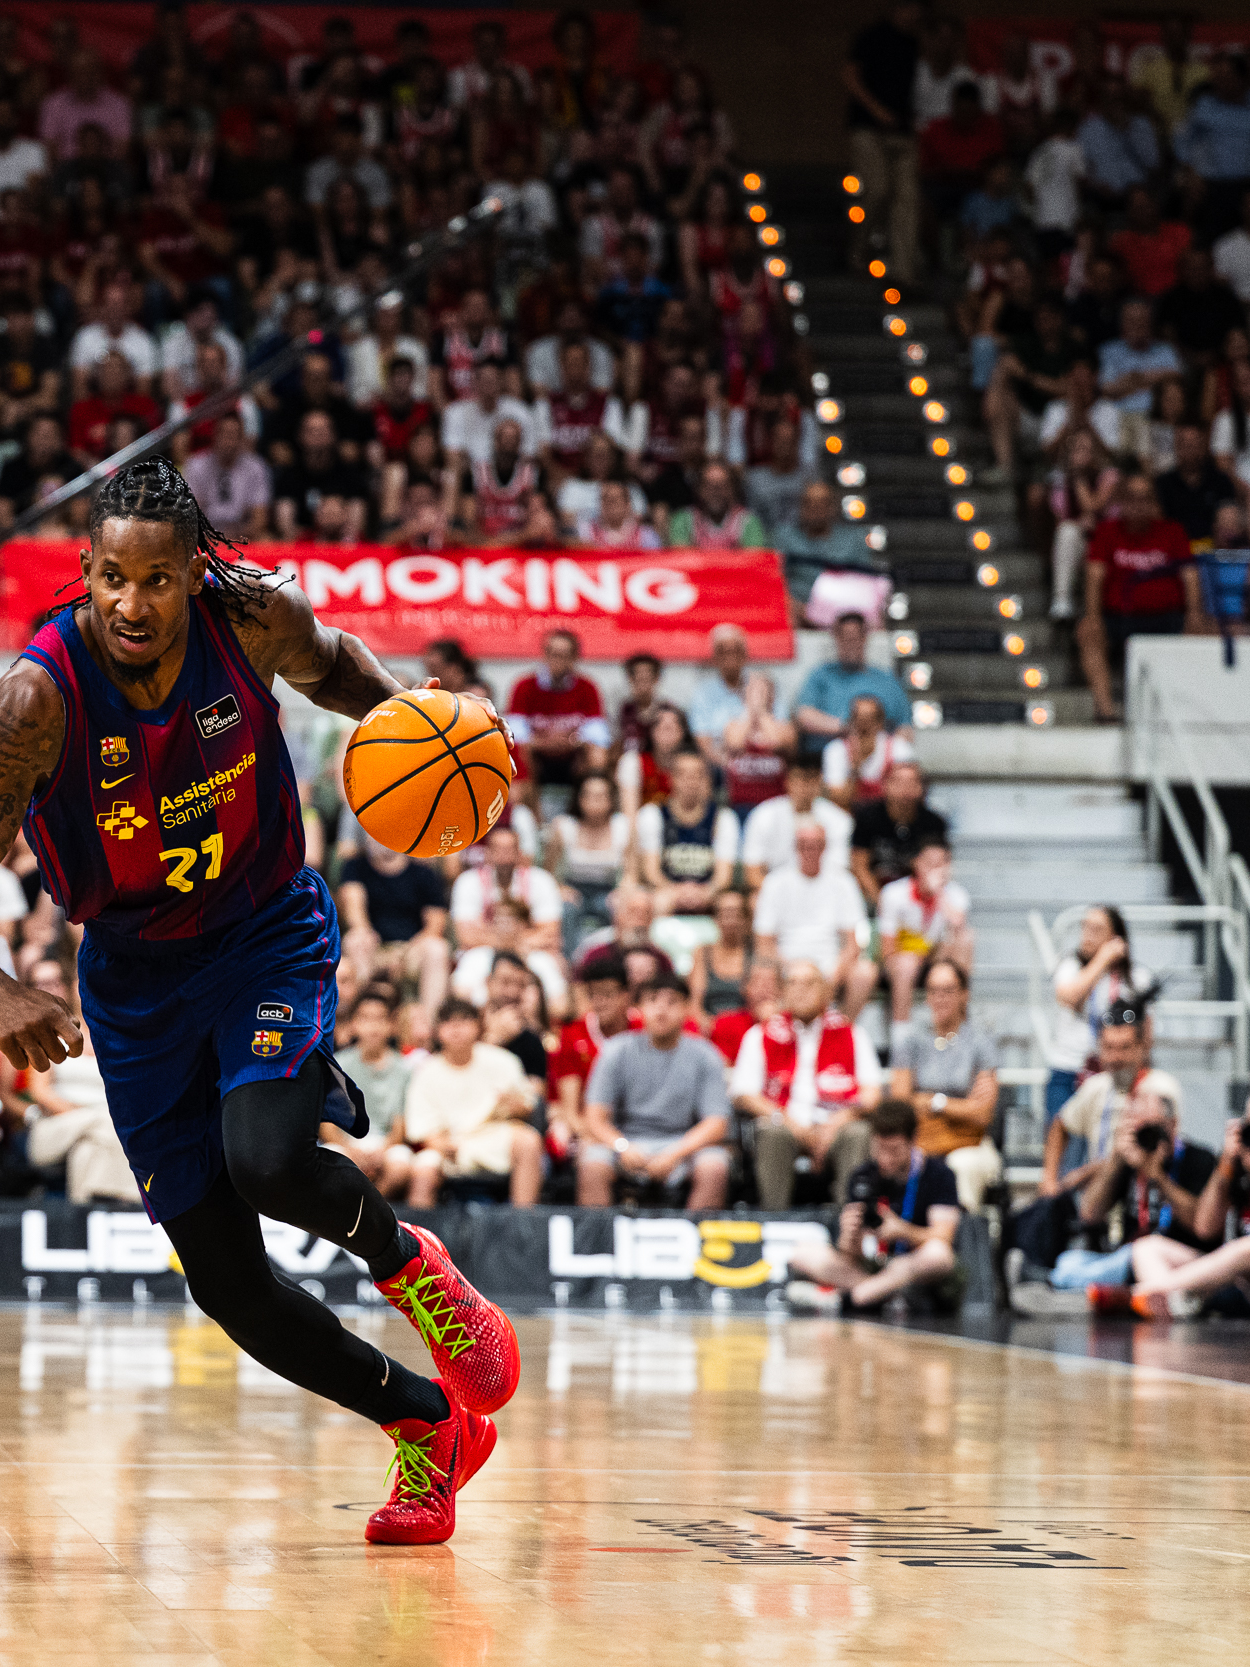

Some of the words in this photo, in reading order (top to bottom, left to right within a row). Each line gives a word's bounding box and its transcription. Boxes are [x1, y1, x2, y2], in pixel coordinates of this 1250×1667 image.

[226, 554, 699, 615] MOKING
[202, 714, 219, 727] liga
[205, 711, 238, 733] endesa
[159, 752, 257, 815] Assistència
[162, 786, 237, 829] Sanitària
[158, 832, 224, 893] 21
[260, 1009, 284, 1018] acb
[549, 1213, 833, 1288] LIBER
[743, 1510, 1128, 1569] PLAYOFF
